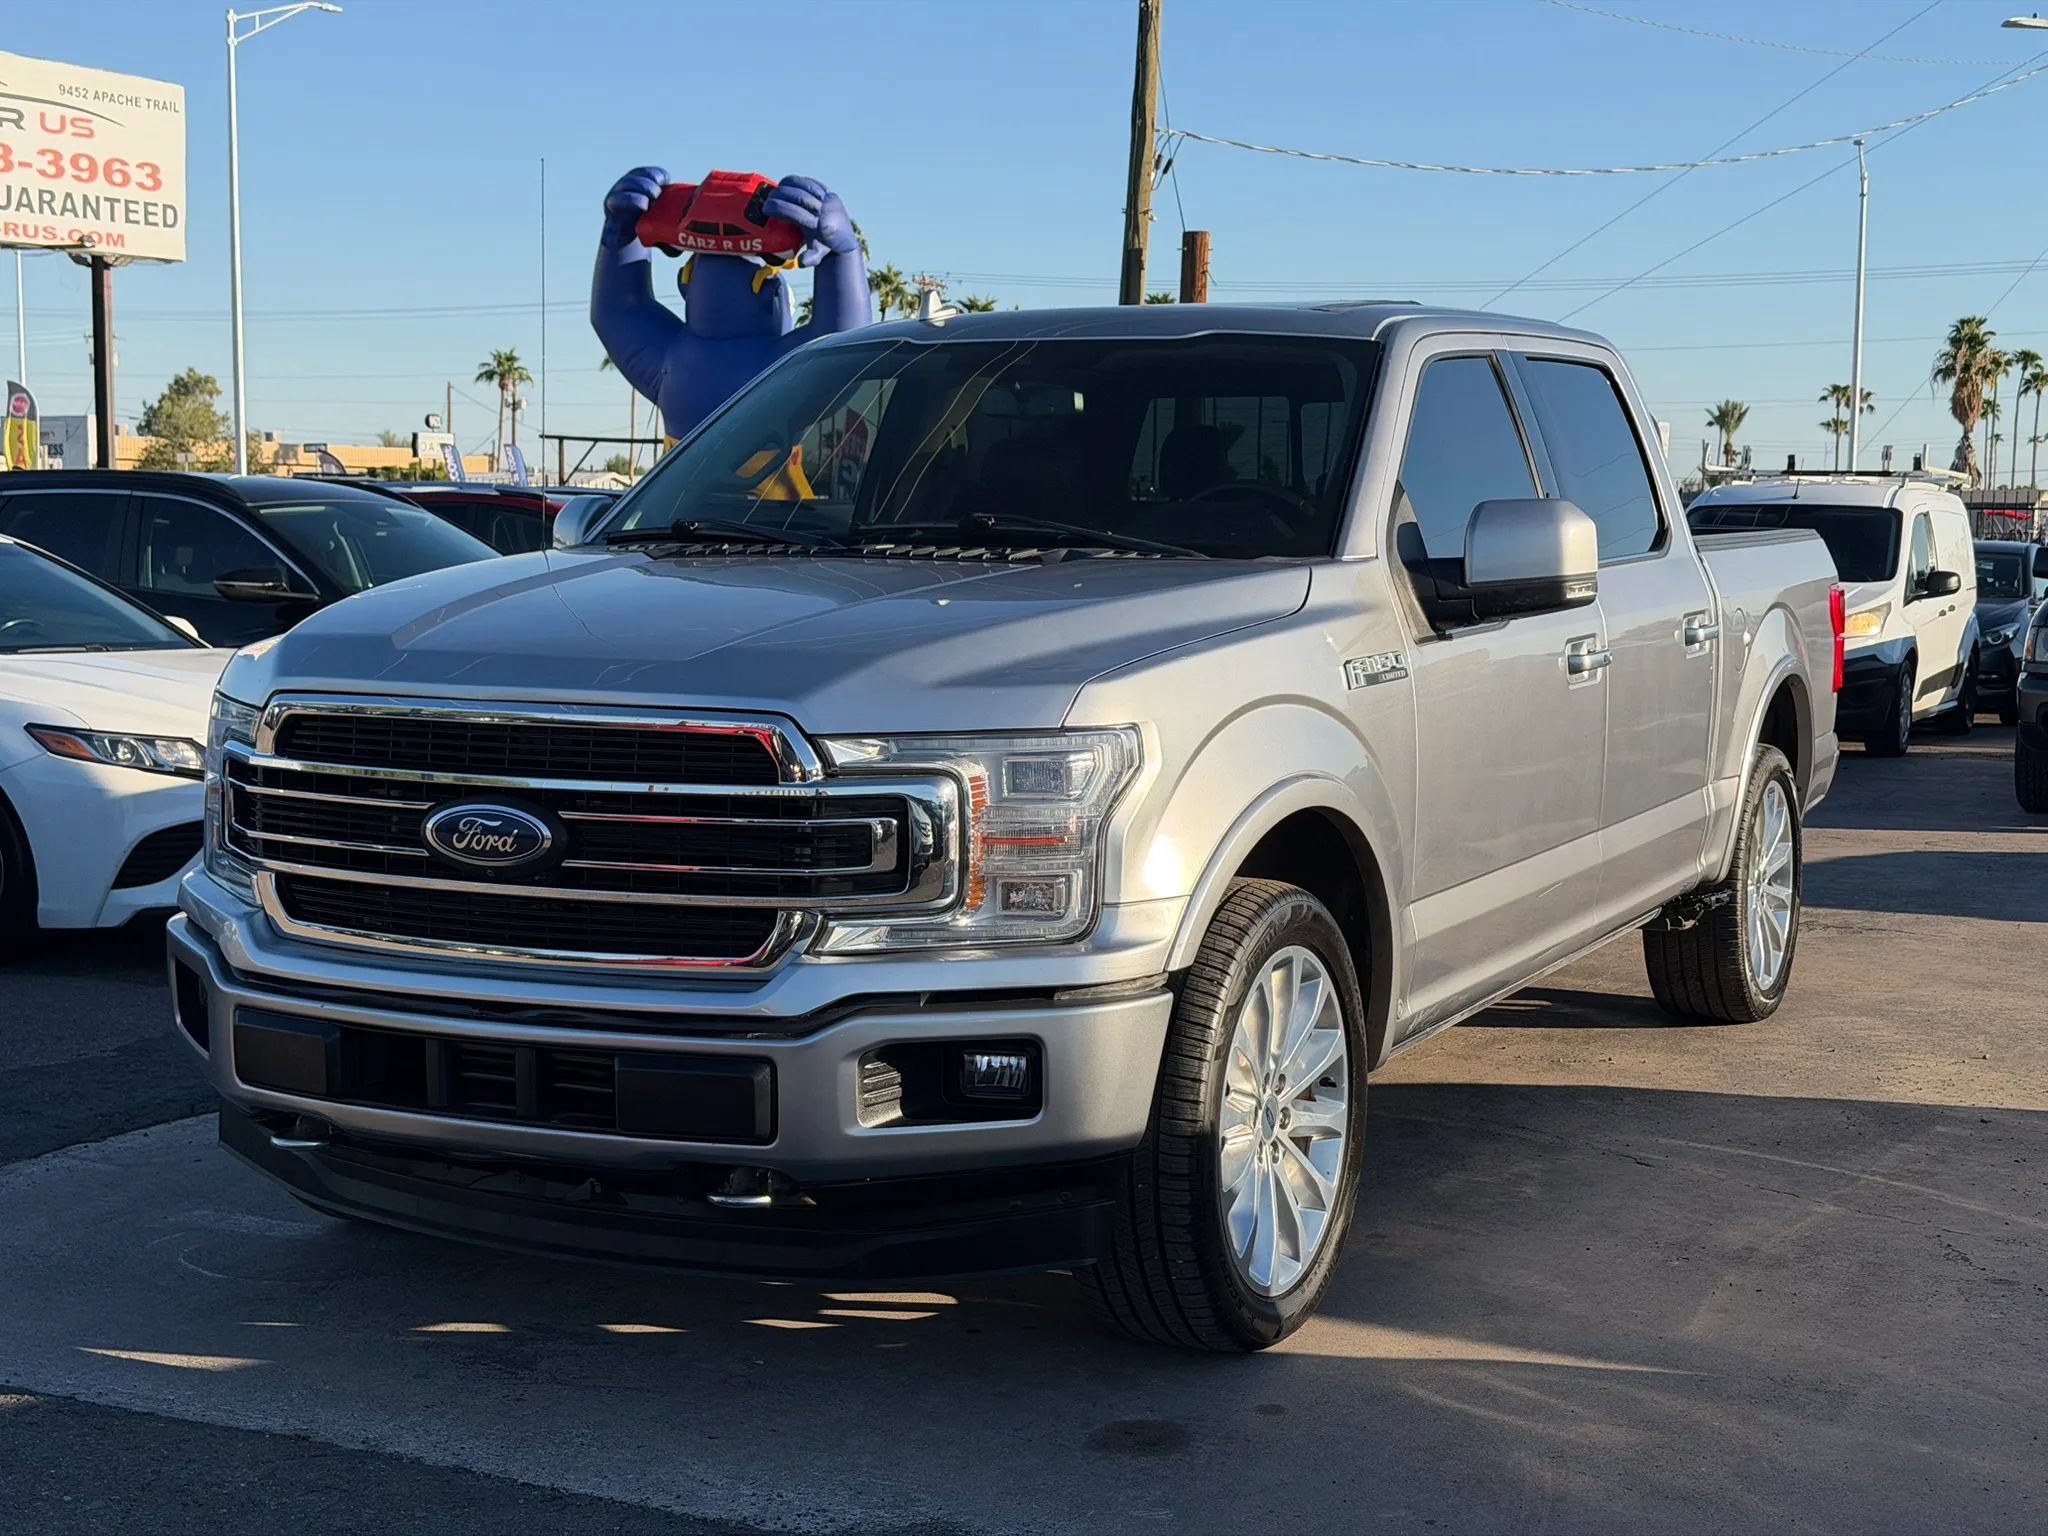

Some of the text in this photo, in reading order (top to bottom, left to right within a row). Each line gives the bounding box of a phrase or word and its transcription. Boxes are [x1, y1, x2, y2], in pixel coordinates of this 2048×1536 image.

[58, 83, 180, 113] 9452 APACHE TRAIL
[0, 106, 95, 139] R US
[0, 221, 126, 248] RUS.COM
[678, 232, 763, 252] CARZ R US
[452, 817, 519, 853] Ford
